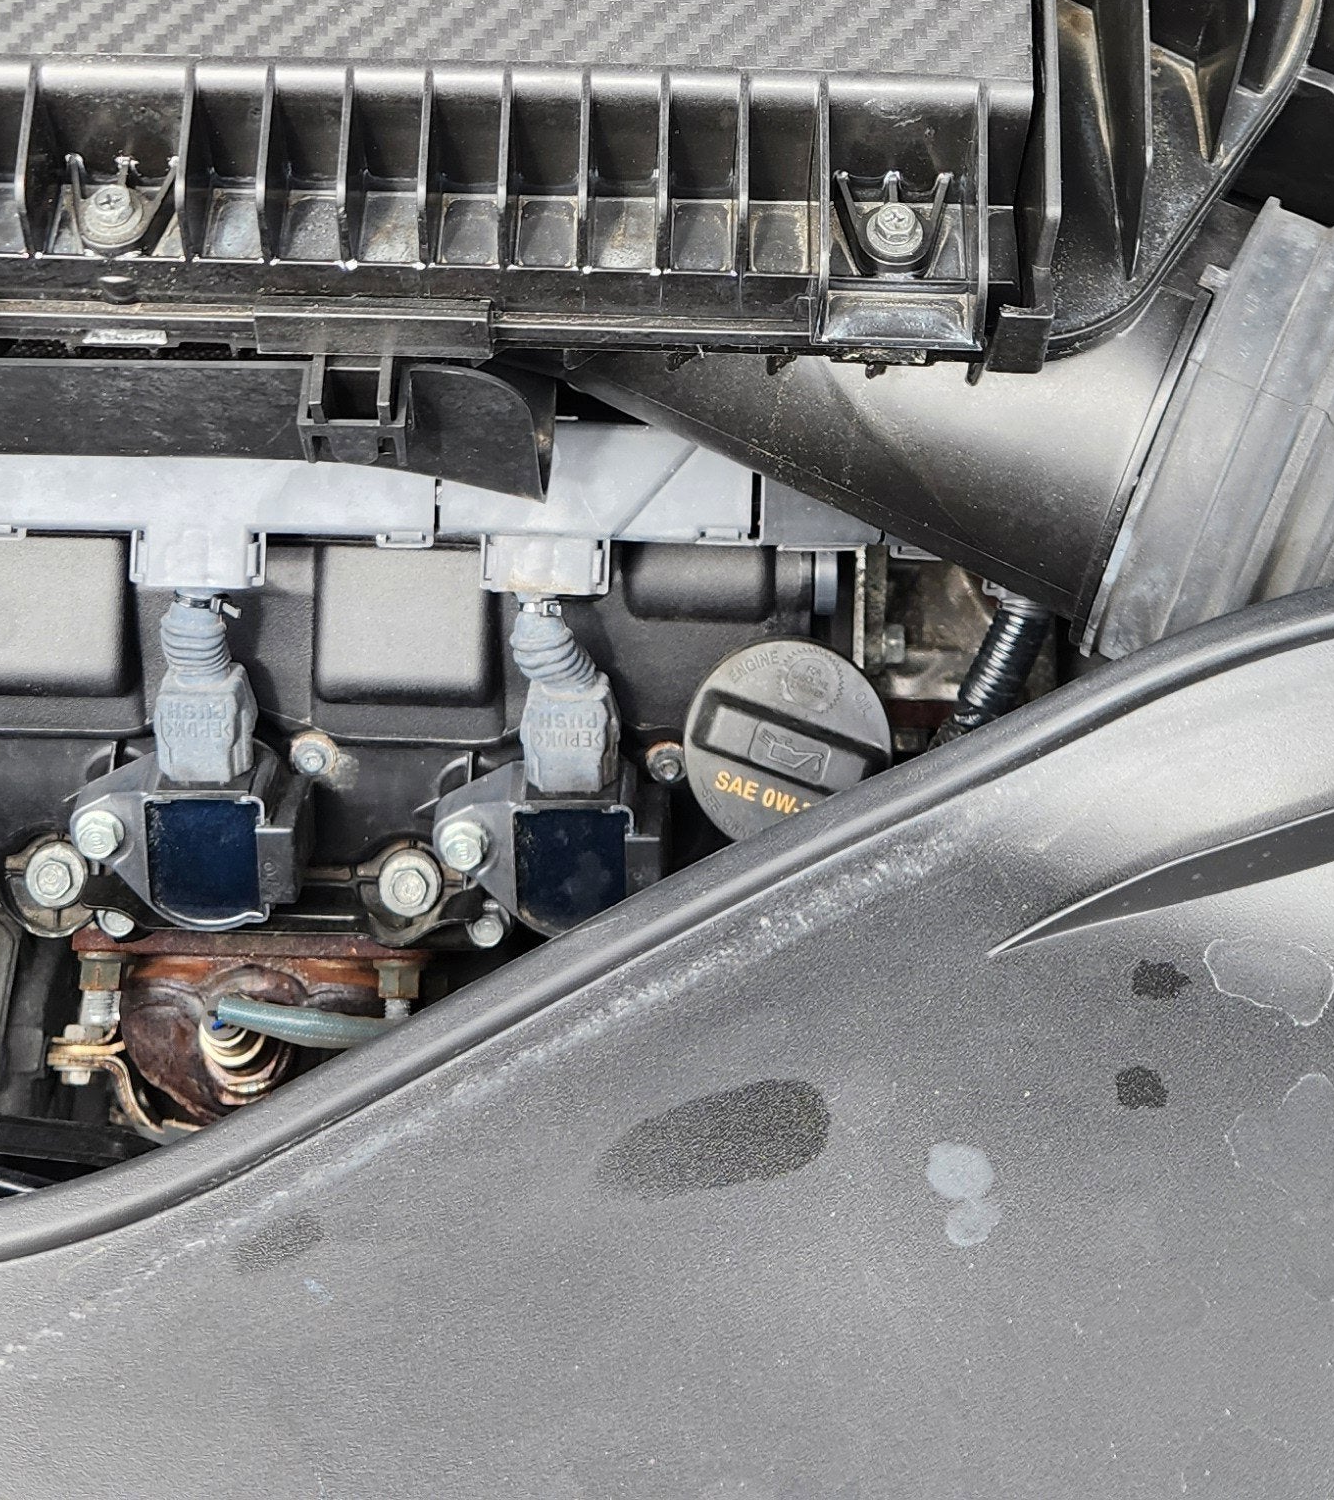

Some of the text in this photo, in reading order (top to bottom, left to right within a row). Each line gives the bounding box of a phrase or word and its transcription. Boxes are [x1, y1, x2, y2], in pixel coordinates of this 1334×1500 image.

[728, 650, 779, 684] ENGINE
[538, 712, 598, 729] PUSH
[714, 770, 812, 814] SAE 0W-
